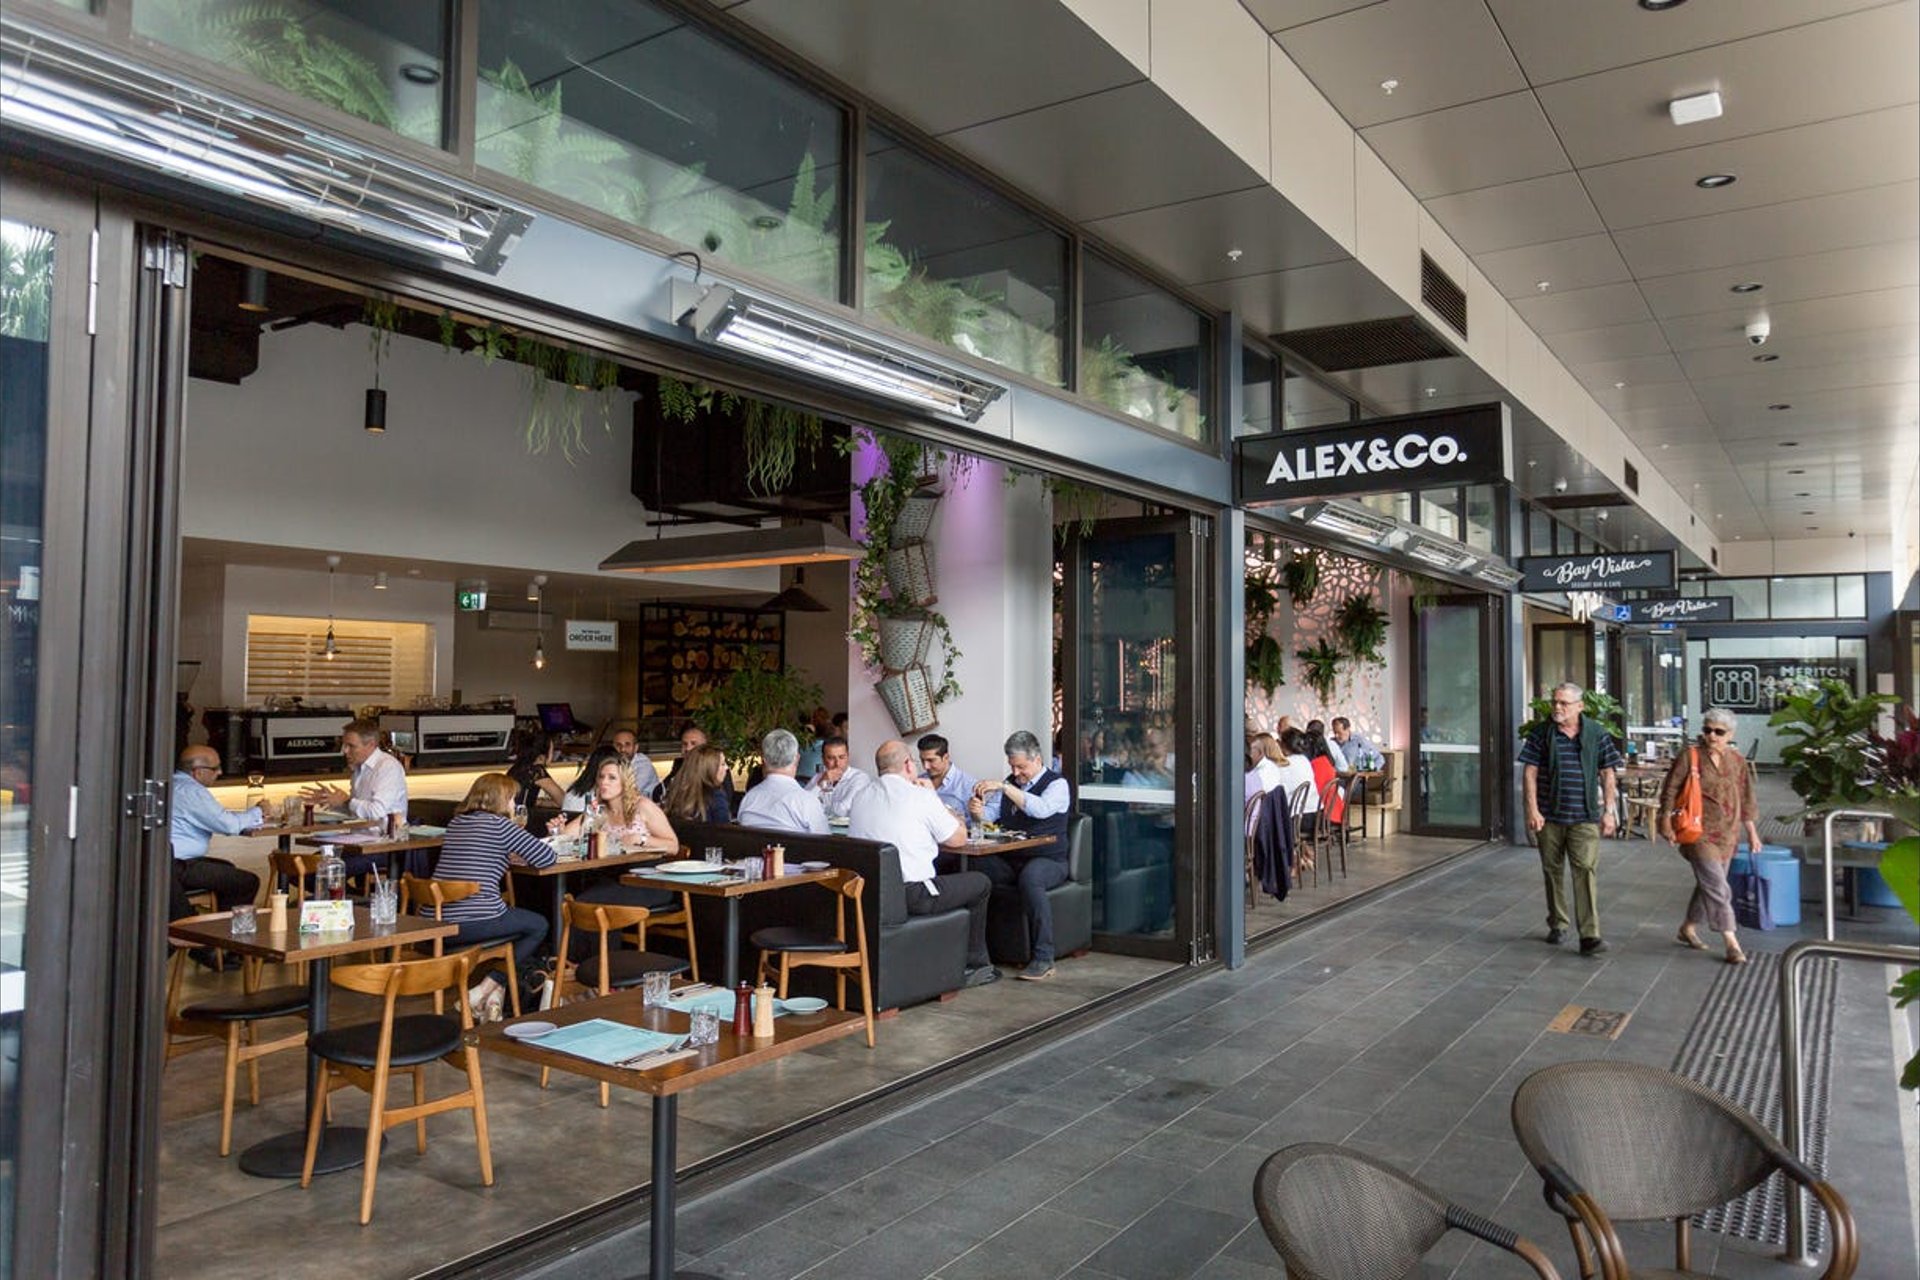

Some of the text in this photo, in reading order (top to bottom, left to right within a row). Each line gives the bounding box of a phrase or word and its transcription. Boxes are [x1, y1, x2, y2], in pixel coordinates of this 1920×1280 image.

[1542, 556, 1652, 584] Bay Vista
[1641, 599, 1718, 619] Bay Vista
[569, 633, 613, 643] ORDER HERE
